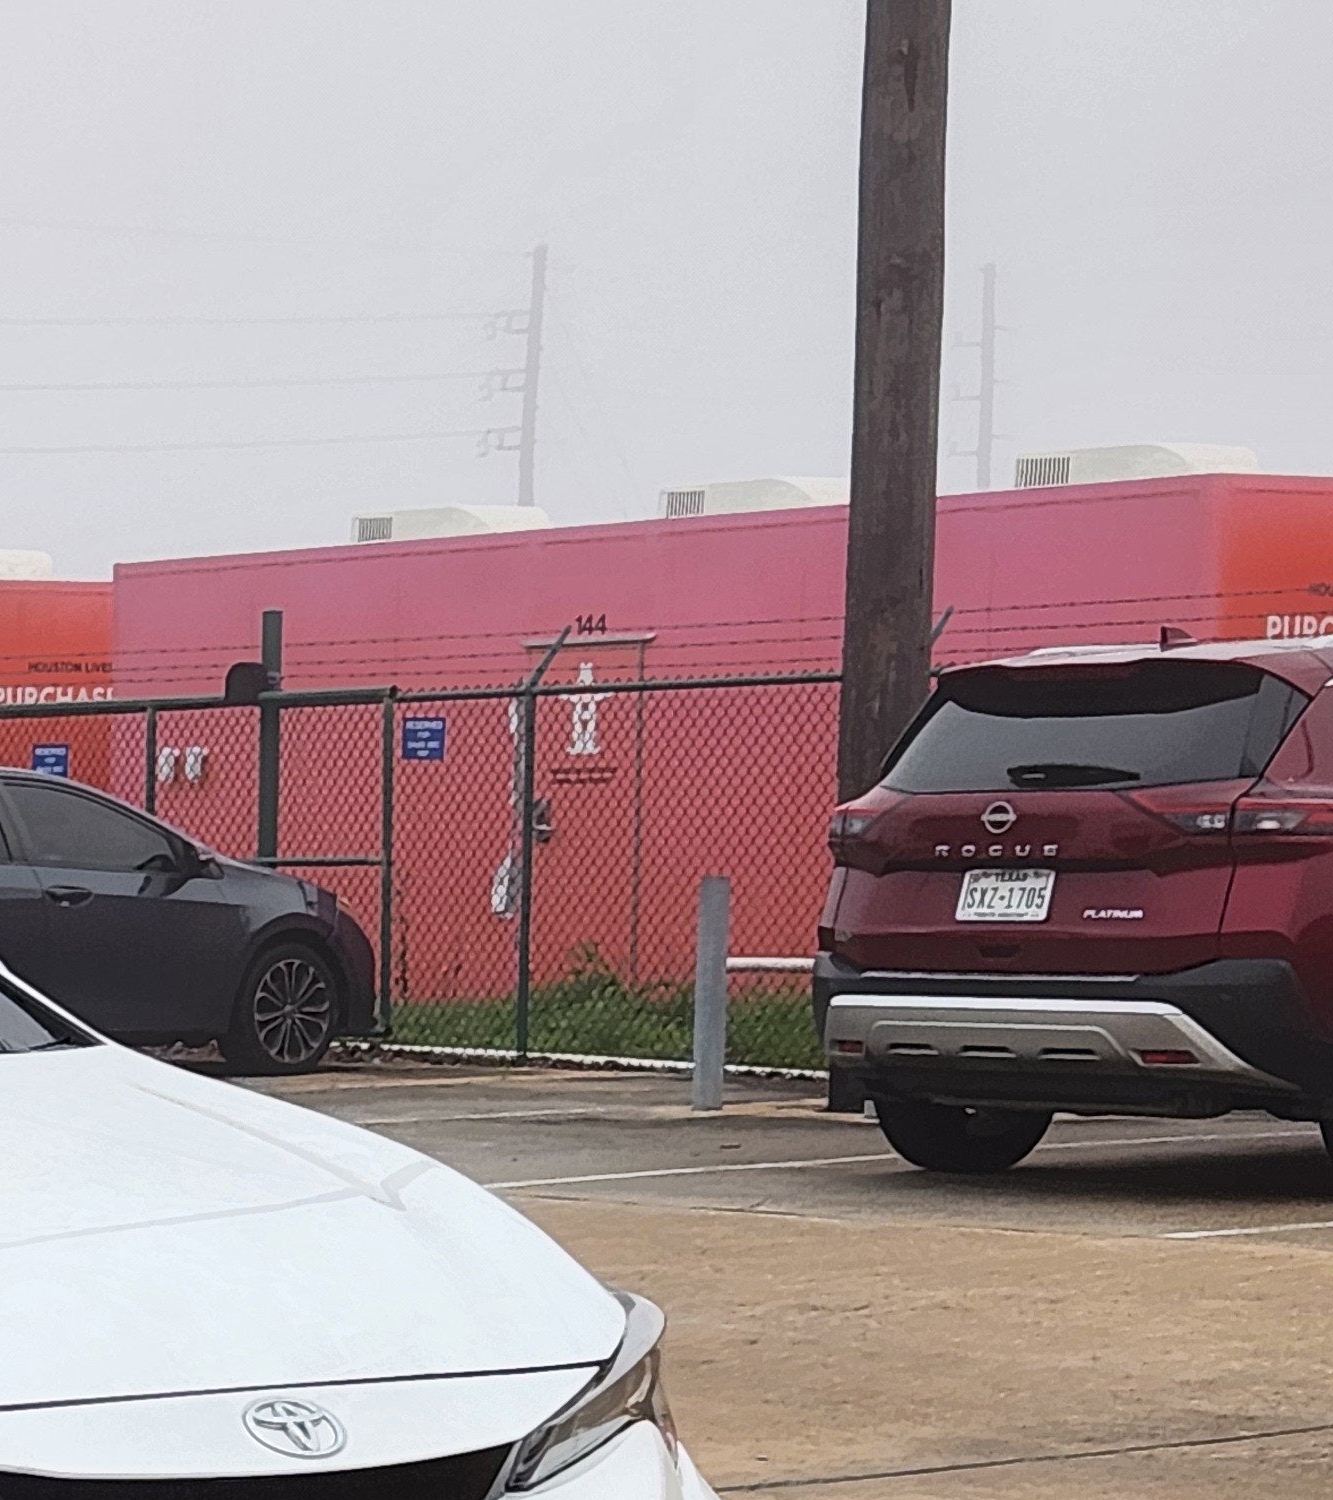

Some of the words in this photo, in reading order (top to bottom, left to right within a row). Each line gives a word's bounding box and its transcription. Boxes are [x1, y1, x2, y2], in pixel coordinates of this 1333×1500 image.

[575, 613, 607, 635] 144
[935, 844, 1058, 857] ROGUE
[1083, 909, 1144, 919] PLATINUM
